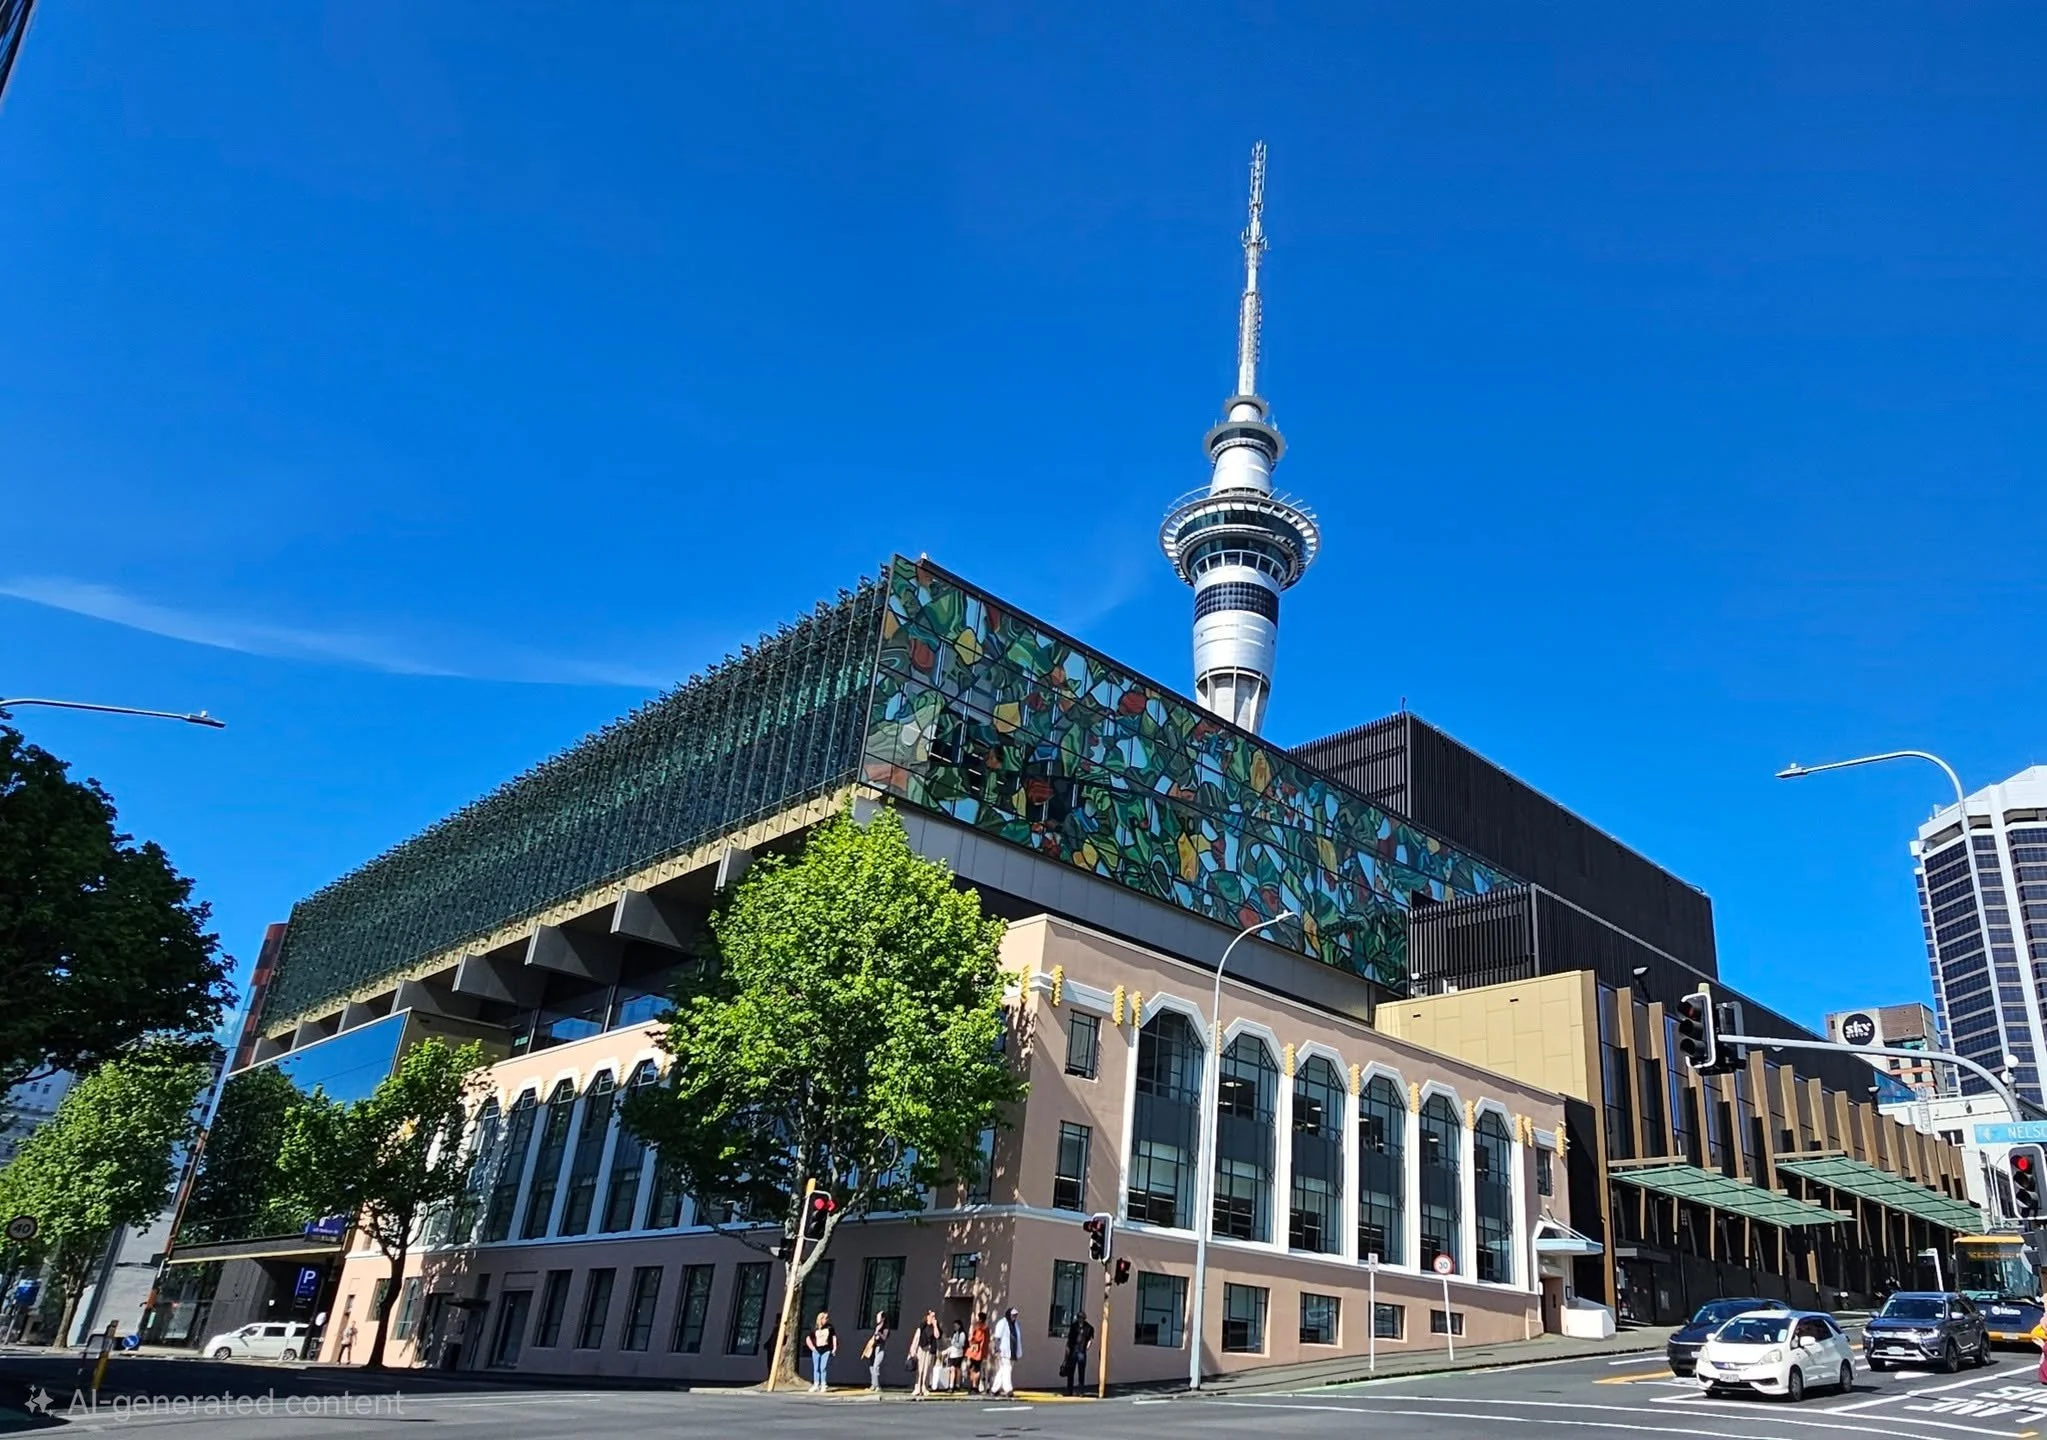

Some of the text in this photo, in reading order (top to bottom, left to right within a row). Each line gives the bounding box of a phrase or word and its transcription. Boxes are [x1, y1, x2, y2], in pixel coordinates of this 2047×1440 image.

[1845, 1020, 1872, 1034] sky
[13, 1224, 31, 1234] 40
[303, 1270, 316, 1284] P
